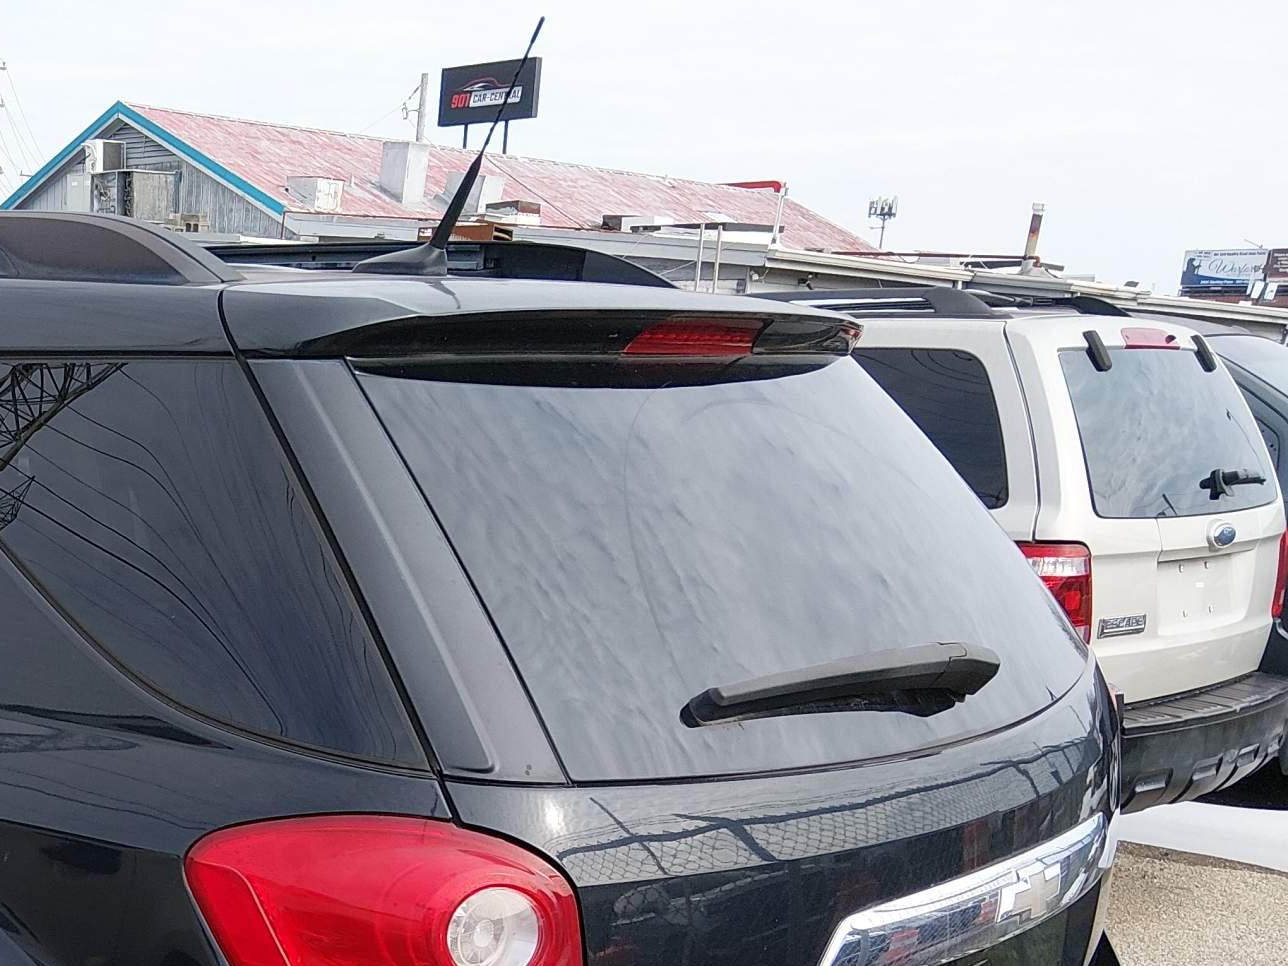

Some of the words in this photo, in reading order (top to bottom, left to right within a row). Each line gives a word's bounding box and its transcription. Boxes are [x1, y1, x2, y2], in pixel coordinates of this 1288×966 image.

[450, 92, 471, 108] 901
[473, 89, 520, 104] CAR-CENAL
[1104, 615, 1144, 629] ESCAPE
